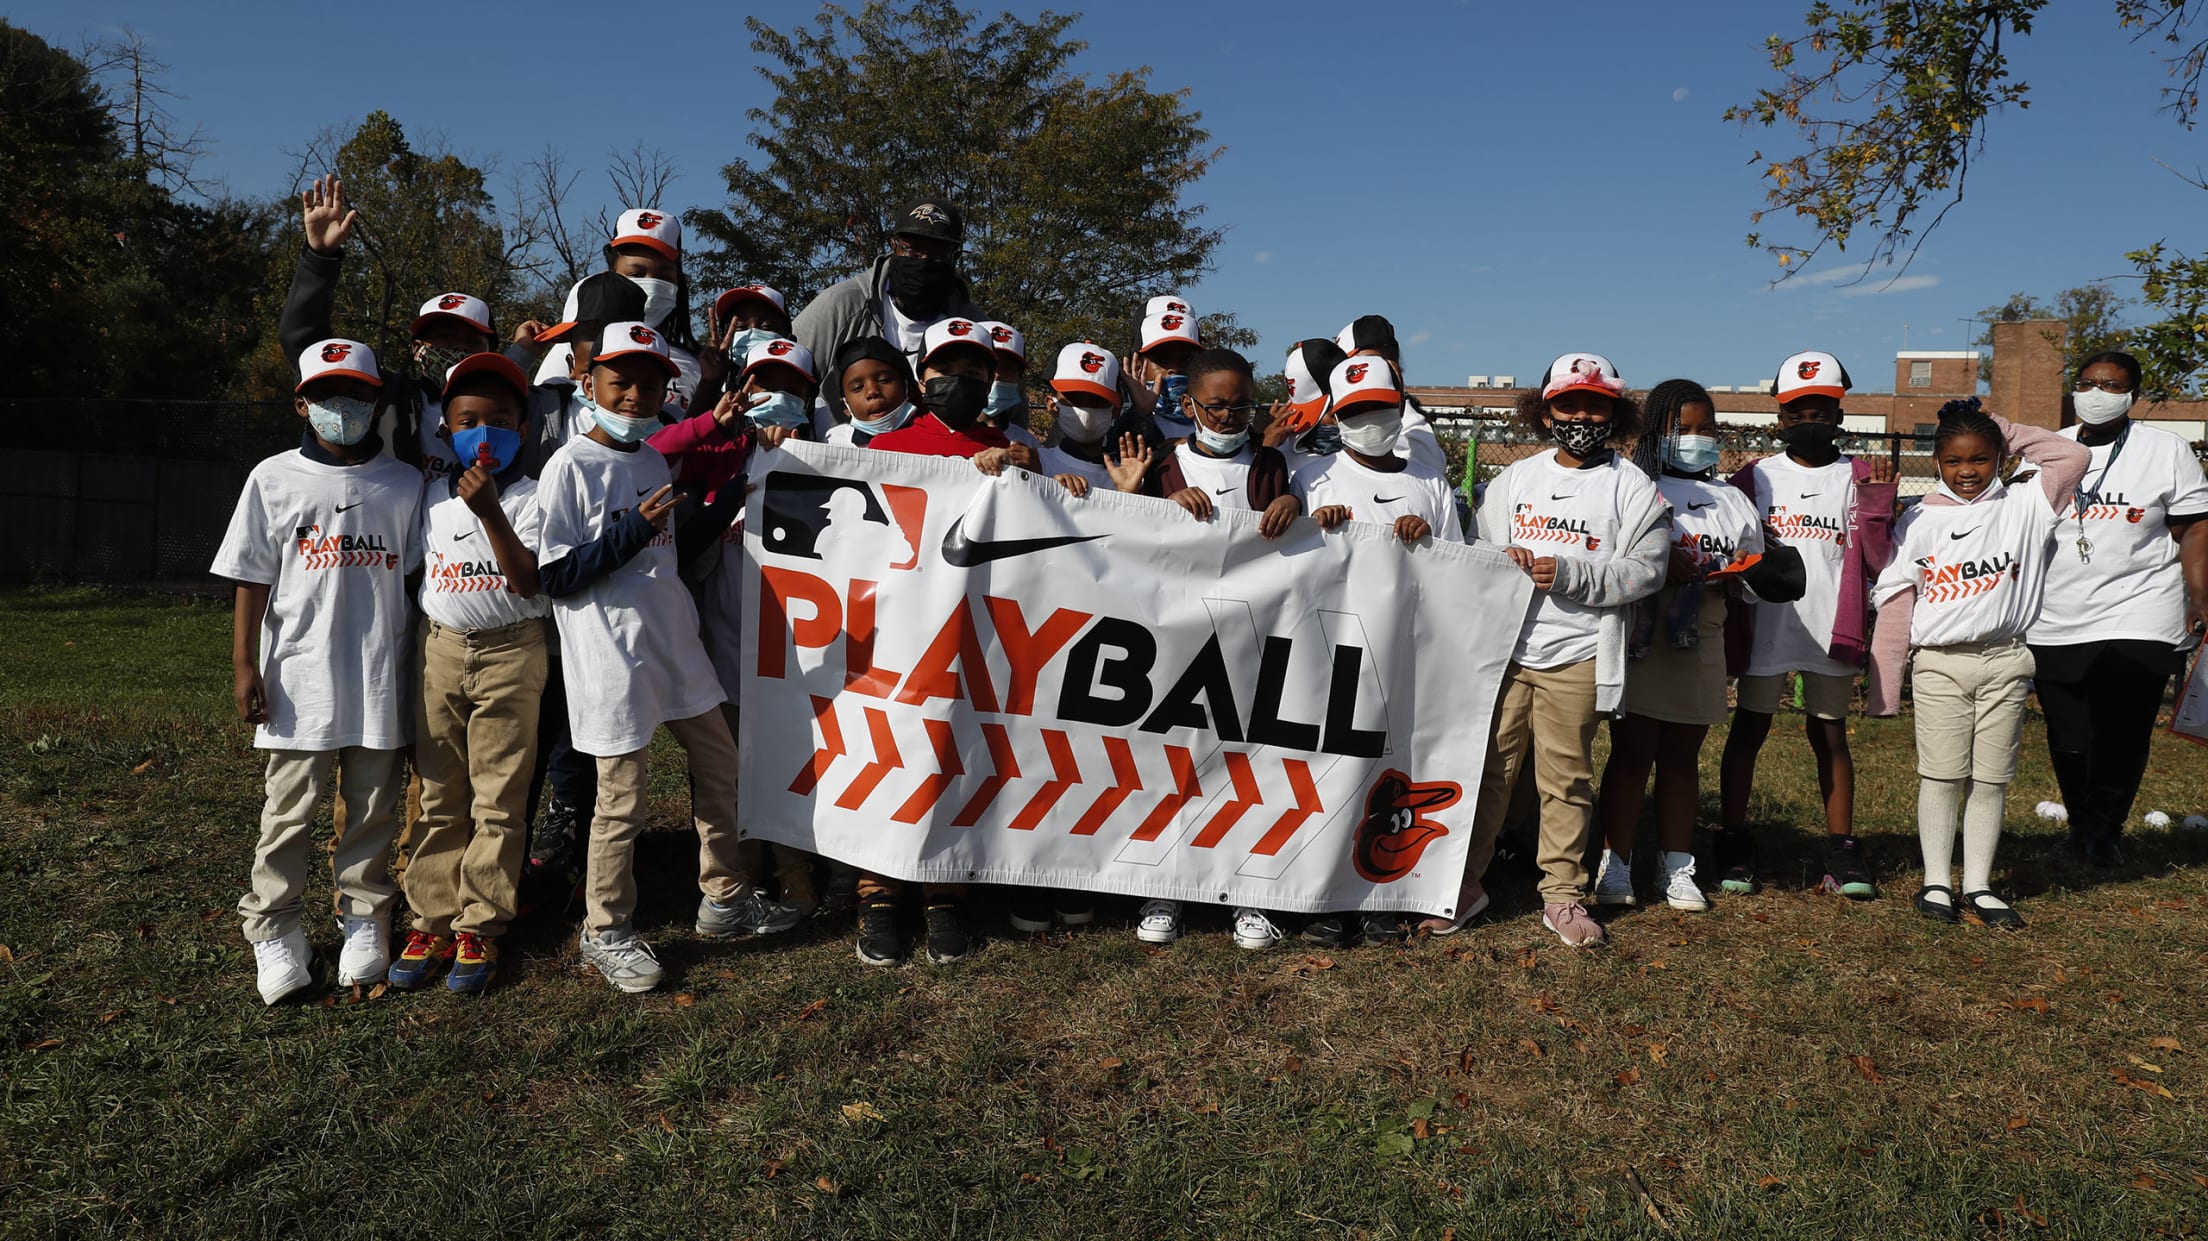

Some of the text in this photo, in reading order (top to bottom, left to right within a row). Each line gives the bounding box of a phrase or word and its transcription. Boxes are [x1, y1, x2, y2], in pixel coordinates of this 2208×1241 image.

[1514, 514, 1590, 534] PLAYBALL
[1768, 514, 1839, 531] PLAYBALL
[298, 535, 387, 556] PLAYBALL
[431, 561, 505, 579] PAYBALL
[1922, 552, 2013, 586] PAYBALL
[757, 565, 1388, 758] PLAYBALL
